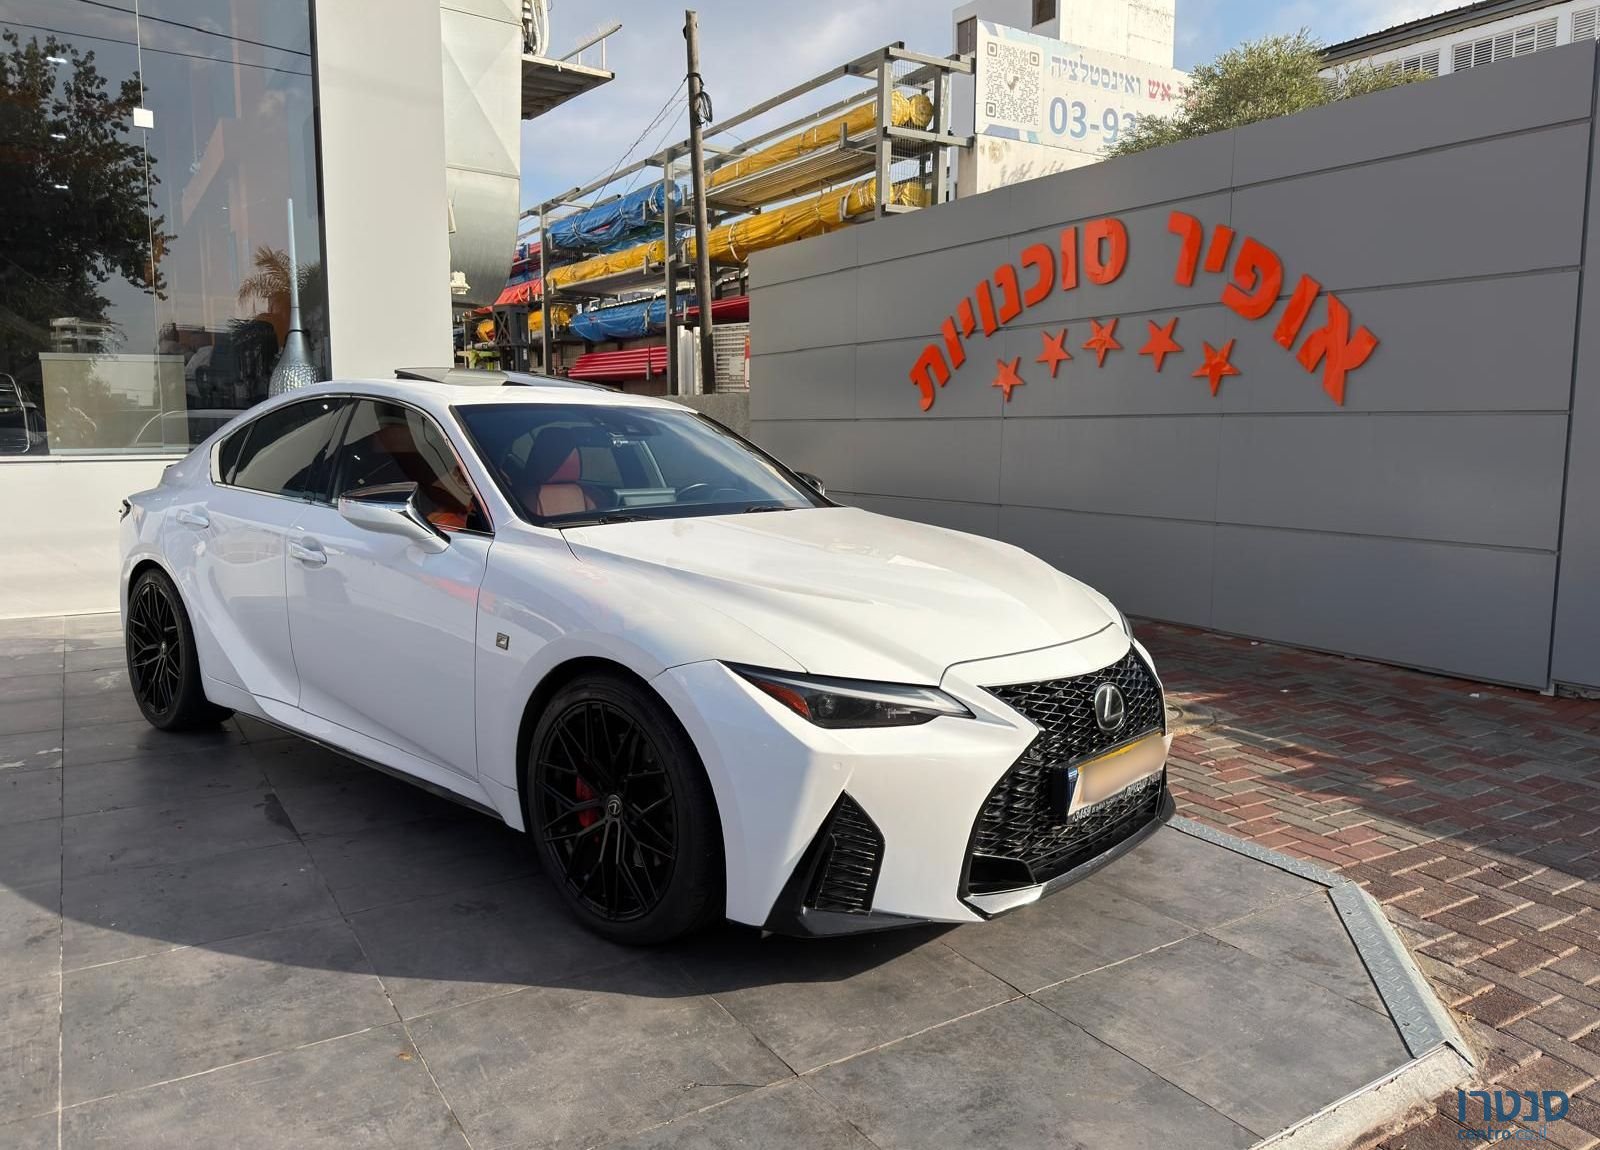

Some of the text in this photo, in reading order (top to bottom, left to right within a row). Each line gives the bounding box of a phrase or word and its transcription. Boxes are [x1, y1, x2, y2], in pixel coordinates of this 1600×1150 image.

[1051, 54, 1141, 95] ואינסטלציה
[1148, 79, 1171, 101] אש
[908, 210, 1379, 412] אופיר סוכנויות
